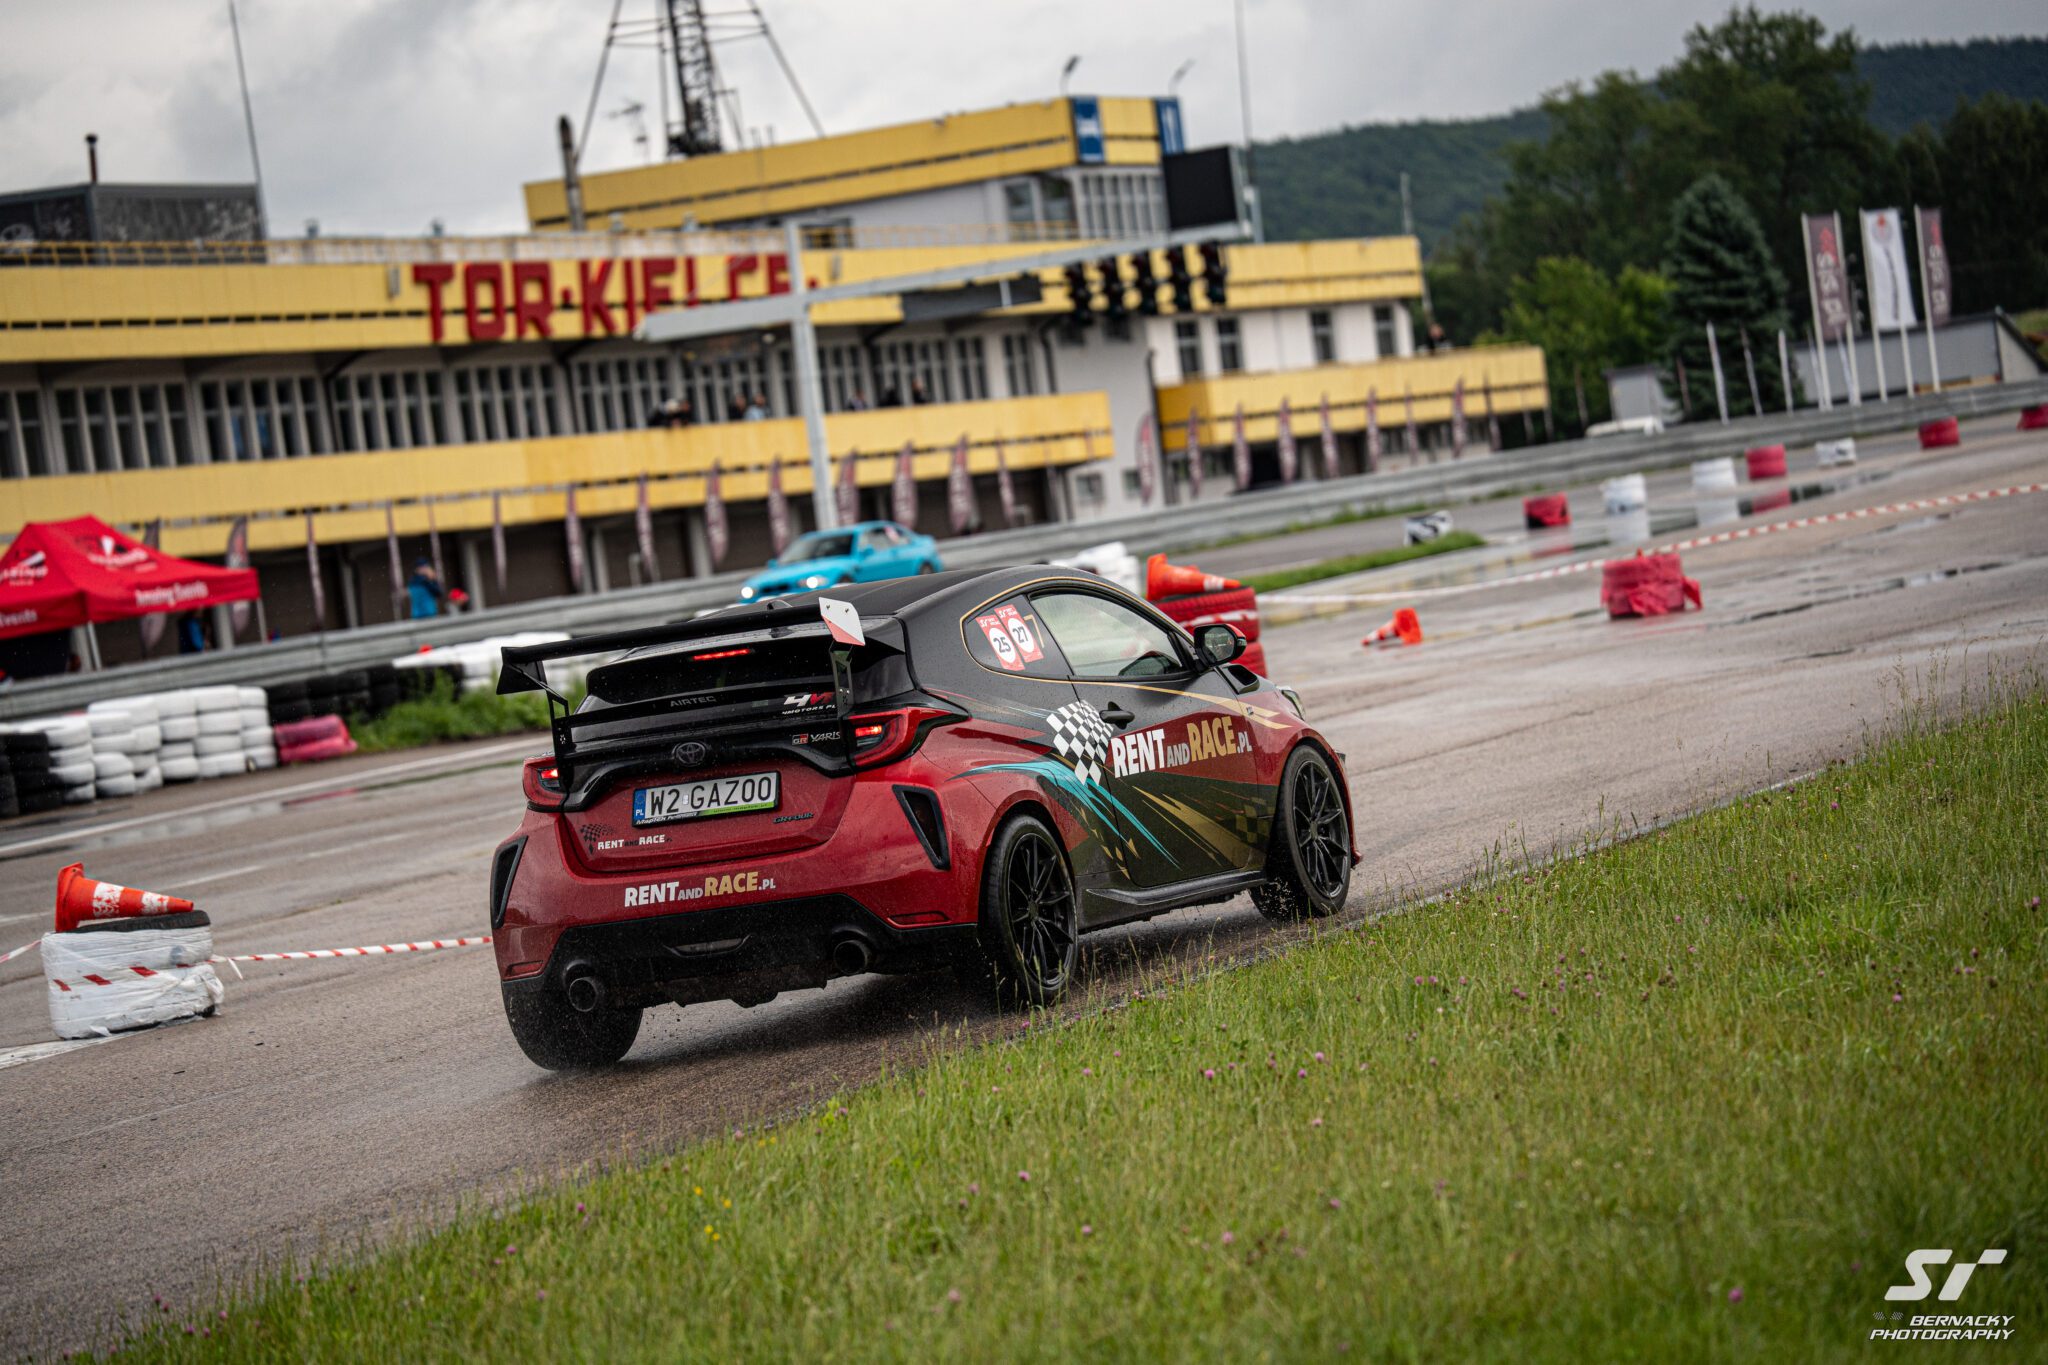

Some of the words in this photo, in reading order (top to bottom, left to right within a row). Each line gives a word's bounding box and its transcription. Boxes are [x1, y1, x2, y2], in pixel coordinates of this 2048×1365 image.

[1012, 626, 1029, 643] 27
[993, 637, 1011, 653] 25
[810, 731, 841, 743] YARIS
[650, 788, 680, 816] W2
